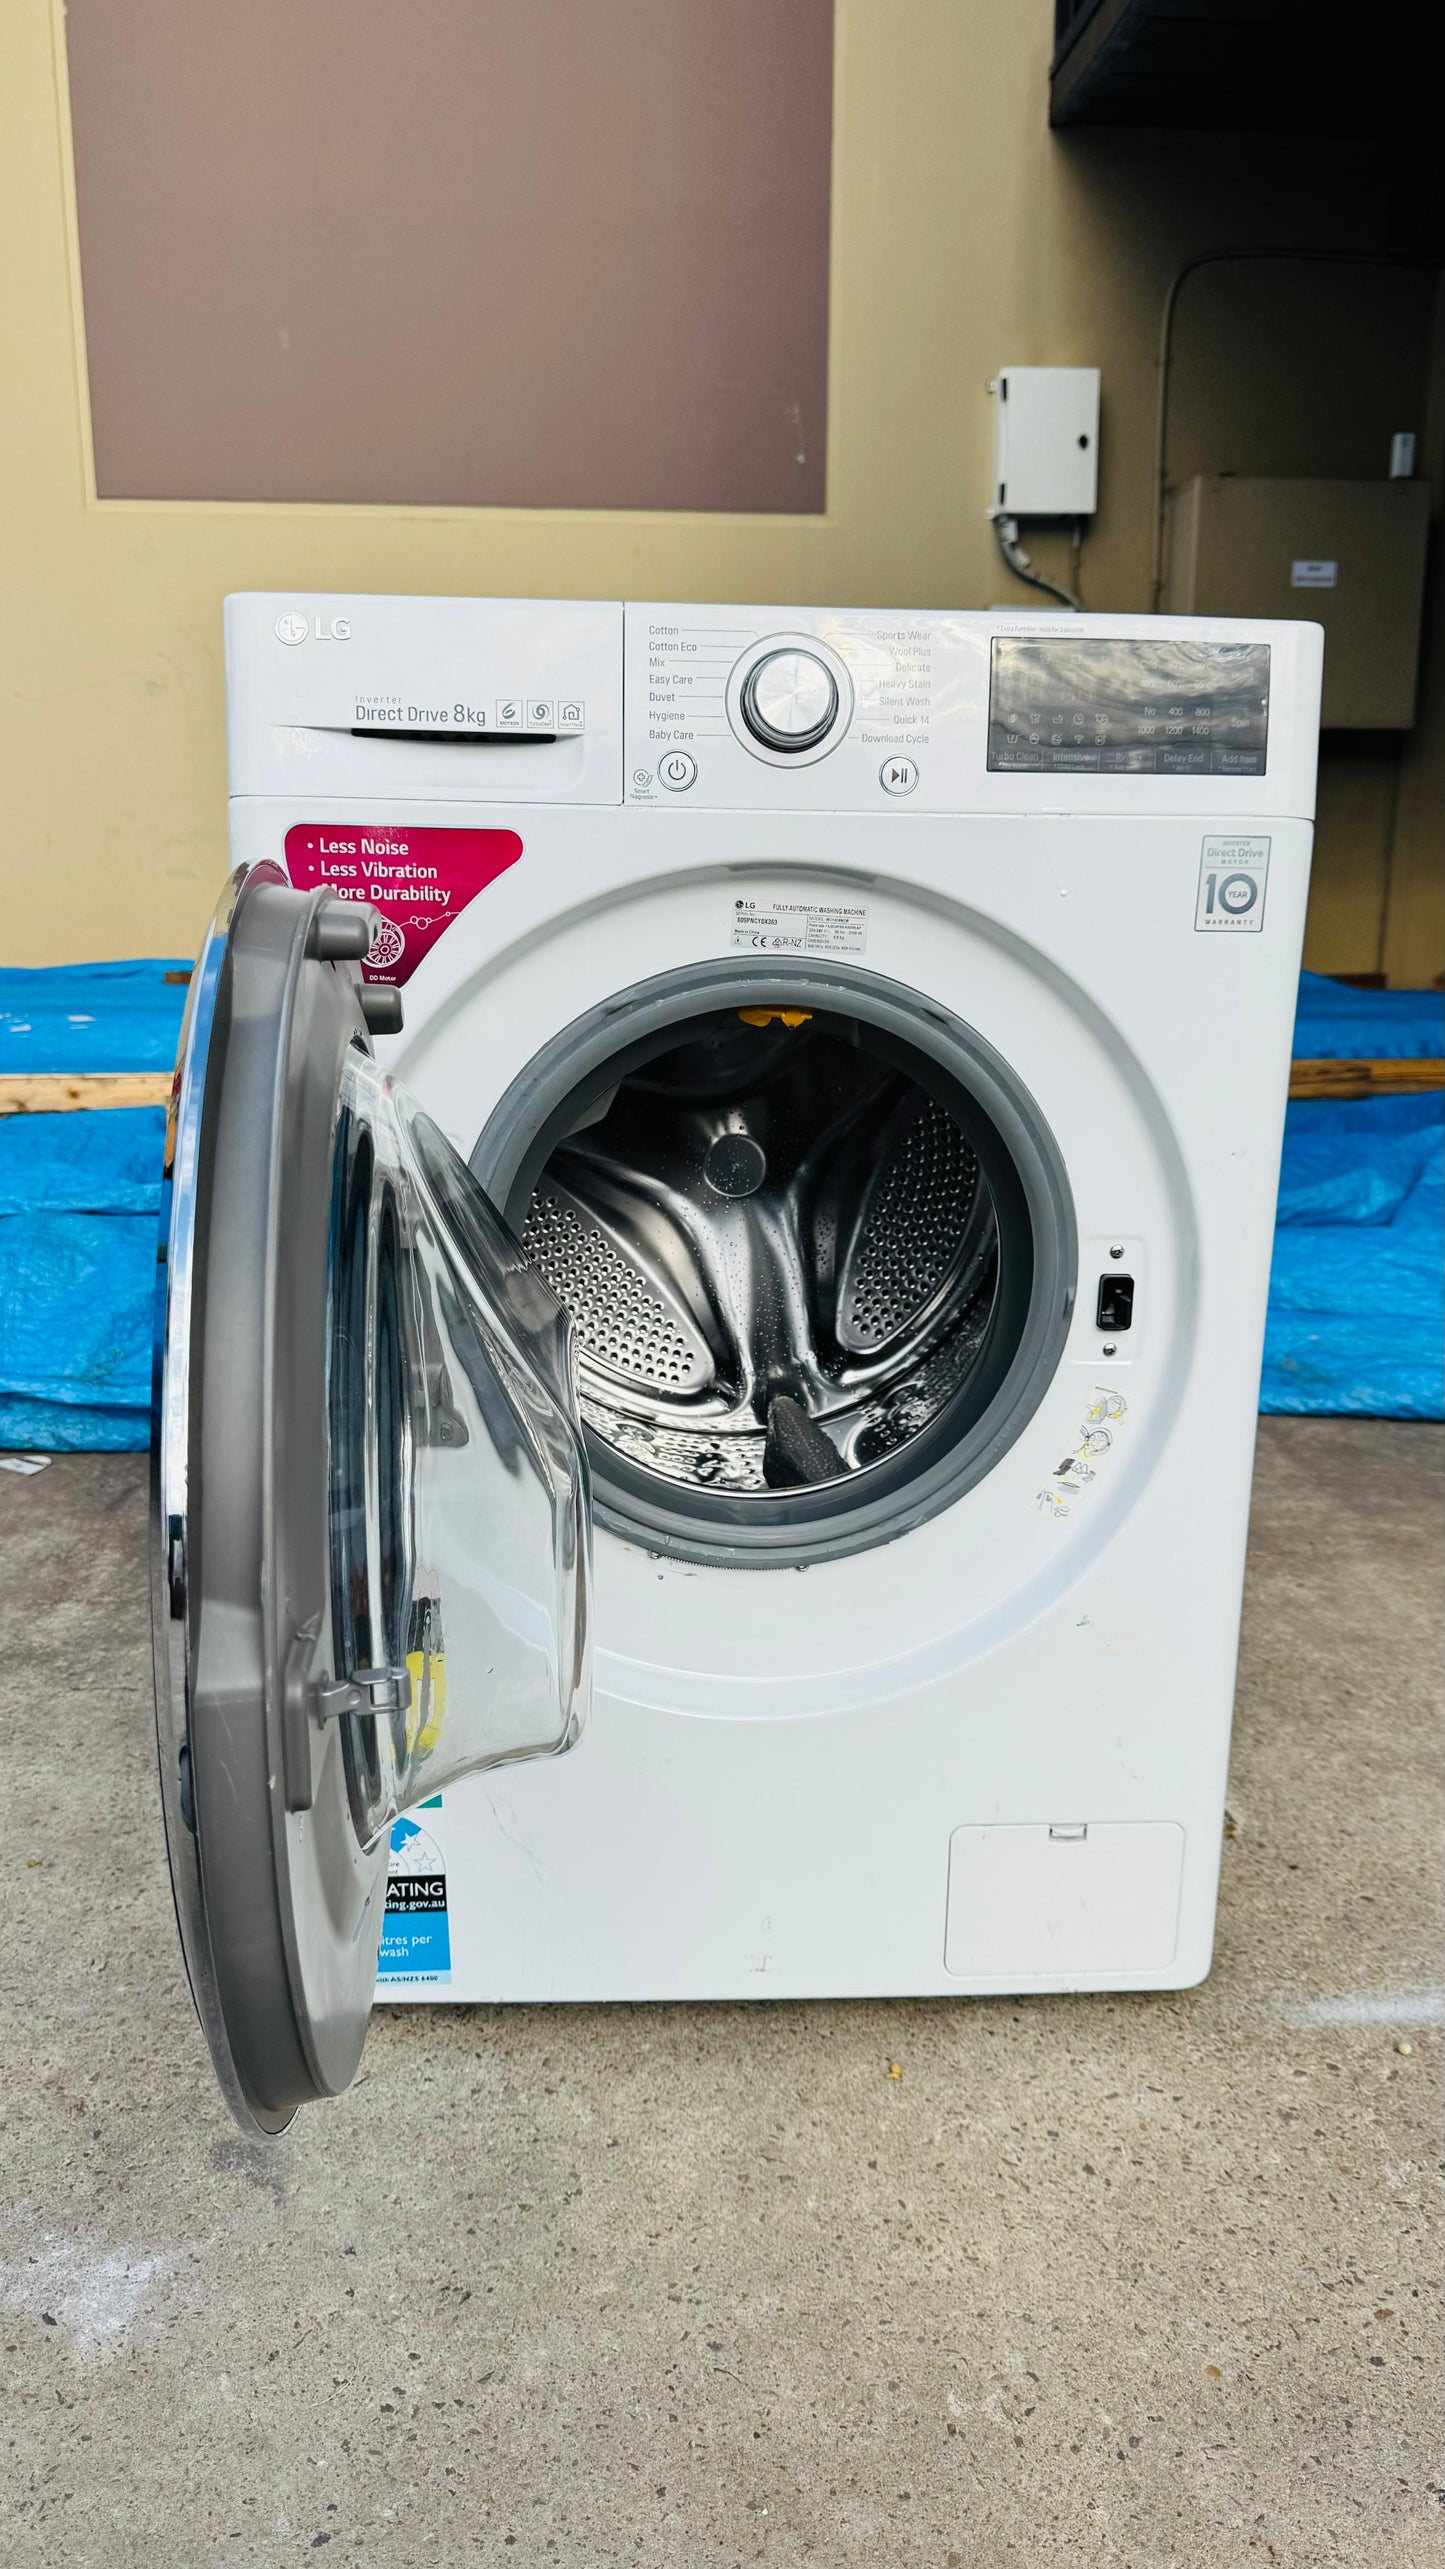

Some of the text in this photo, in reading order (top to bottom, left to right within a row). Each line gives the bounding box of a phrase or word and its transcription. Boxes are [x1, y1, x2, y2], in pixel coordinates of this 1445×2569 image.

[314, 616, 352, 641] LG
[648, 625, 679, 636] Cotton
[875, 631, 931, 642] Sports Wear
[648, 642, 697, 652] Cotton Eco
[889, 646, 931, 657] Wool Plus
[648, 657, 665, 667] Mix
[895, 662, 931, 673] Delicate
[648, 674, 693, 687] Easy Care
[878, 679, 931, 691] Heavy Stain
[355, 695, 402, 704] Inverter
[648, 692, 675, 703] Duvet
[878, 696, 931, 707] Silent Wash
[355, 704, 486, 726] Direct Drive 8kg
[648, 710, 685, 723] Hygiene
[1144, 707, 1157, 716] No
[1168, 707, 1183, 716] 400
[1195, 707, 1211, 717] 800
[893, 715, 930, 726] Quick 14
[648, 729, 694, 742] Baby Care
[1138, 726, 1155, 735] 1000
[1166, 726, 1183, 735] 1200
[1192, 726, 1209, 735] 1400
[861, 733, 930, 746] Download Cycle
[991, 752, 1039, 761] Turbo Clean
[1164, 753, 1204, 764] Delay End
[1222, 755, 1238, 764] Add
[319, 838, 409, 855] Less Noise
[1207, 848, 1264, 858] Direct Drive
[320, 861, 438, 879] Less Vibration
[370, 884, 451, 906] Durability
[1205, 872, 1258, 915] 10
[1227, 890, 1248, 898] YEAR
[772, 903, 788, 911] FULLY
[818, 907, 843, 915] WASHING
[843, 908, 866, 916] MACHINE
[386, 1882, 443, 1897] ATING
[385, 1899, 446, 1912] ting.gov.au
[381, 1935, 432, 1948] itres per
[379, 1946, 409, 1957] wash
